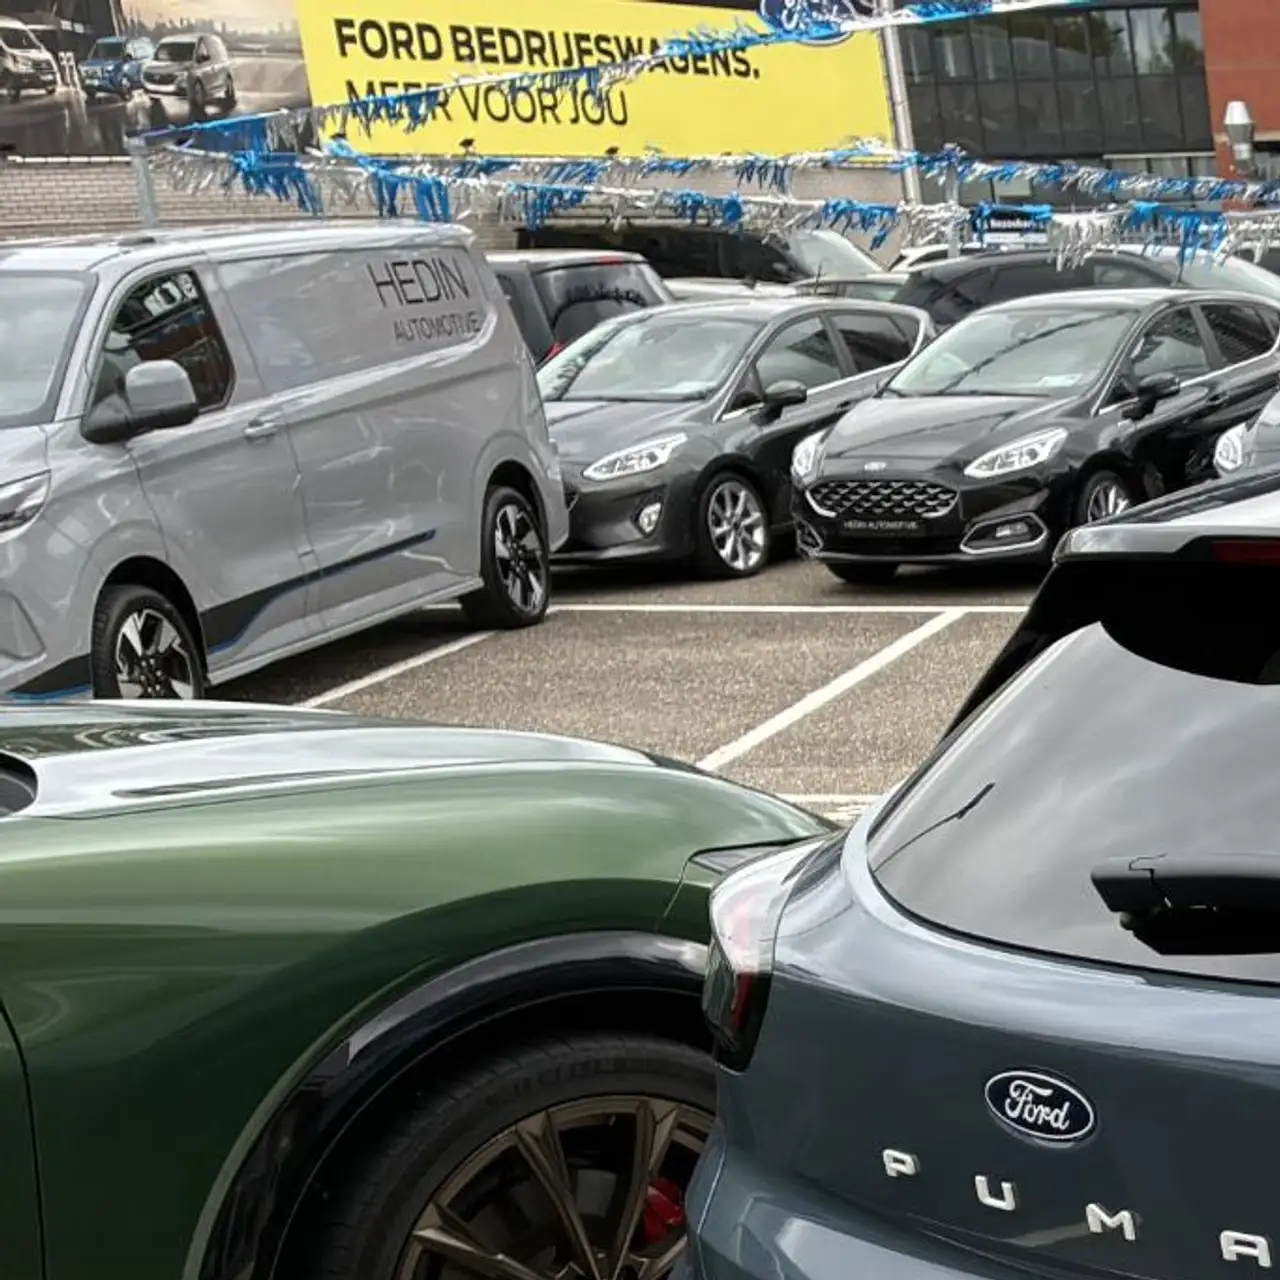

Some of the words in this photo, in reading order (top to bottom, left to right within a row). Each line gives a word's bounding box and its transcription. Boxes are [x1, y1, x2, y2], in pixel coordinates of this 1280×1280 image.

[333, 18, 443, 60] FORD
[366, 257, 470, 307] HEDIN
[393, 311, 481, 341] AUTOMOTIVE
[1005, 1079, 1070, 1130] Ford
[882, 1148, 1273, 1269] PUMA
